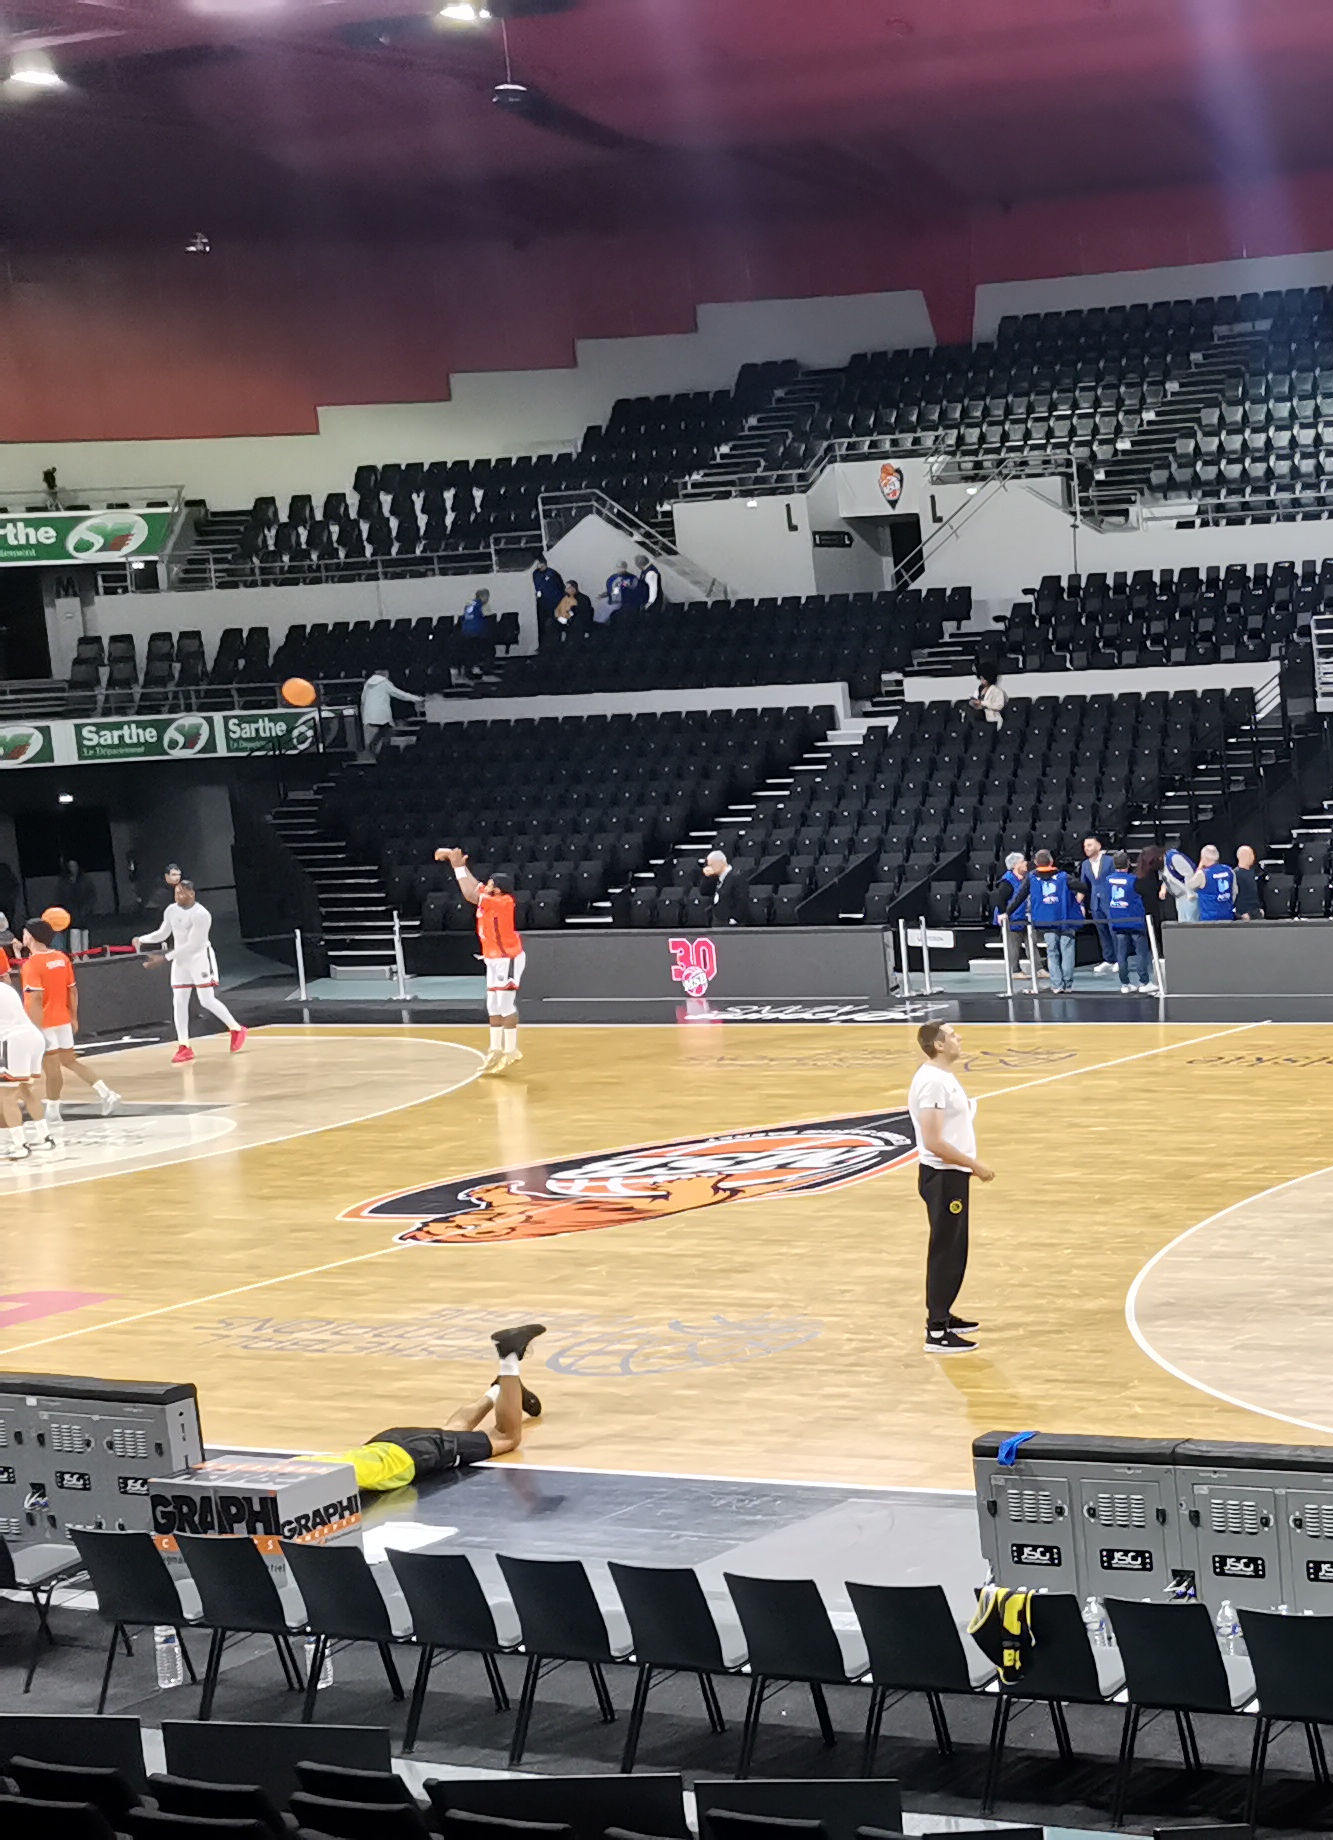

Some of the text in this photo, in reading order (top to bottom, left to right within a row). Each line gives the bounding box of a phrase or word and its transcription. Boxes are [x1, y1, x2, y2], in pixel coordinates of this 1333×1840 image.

[785, 503, 798, 531] L
[930, 494, 943, 523] L
[0, 521, 57, 546] the
[81, 722, 158, 746] Sarthe
[229, 716, 287, 739] Sarthe
[668, 937, 717, 982] 30
[683, 972, 708, 992] MSB
[548, 1145, 898, 1180] MSB
[151, 1494, 283, 1536] GRAPHI
[281, 1493, 360, 1539] GRAPHI
[1021, 1547, 1050, 1559] JSG
[1111, 1552, 1141, 1565] JSG
[1223, 1558, 1253, 1571] JSG
